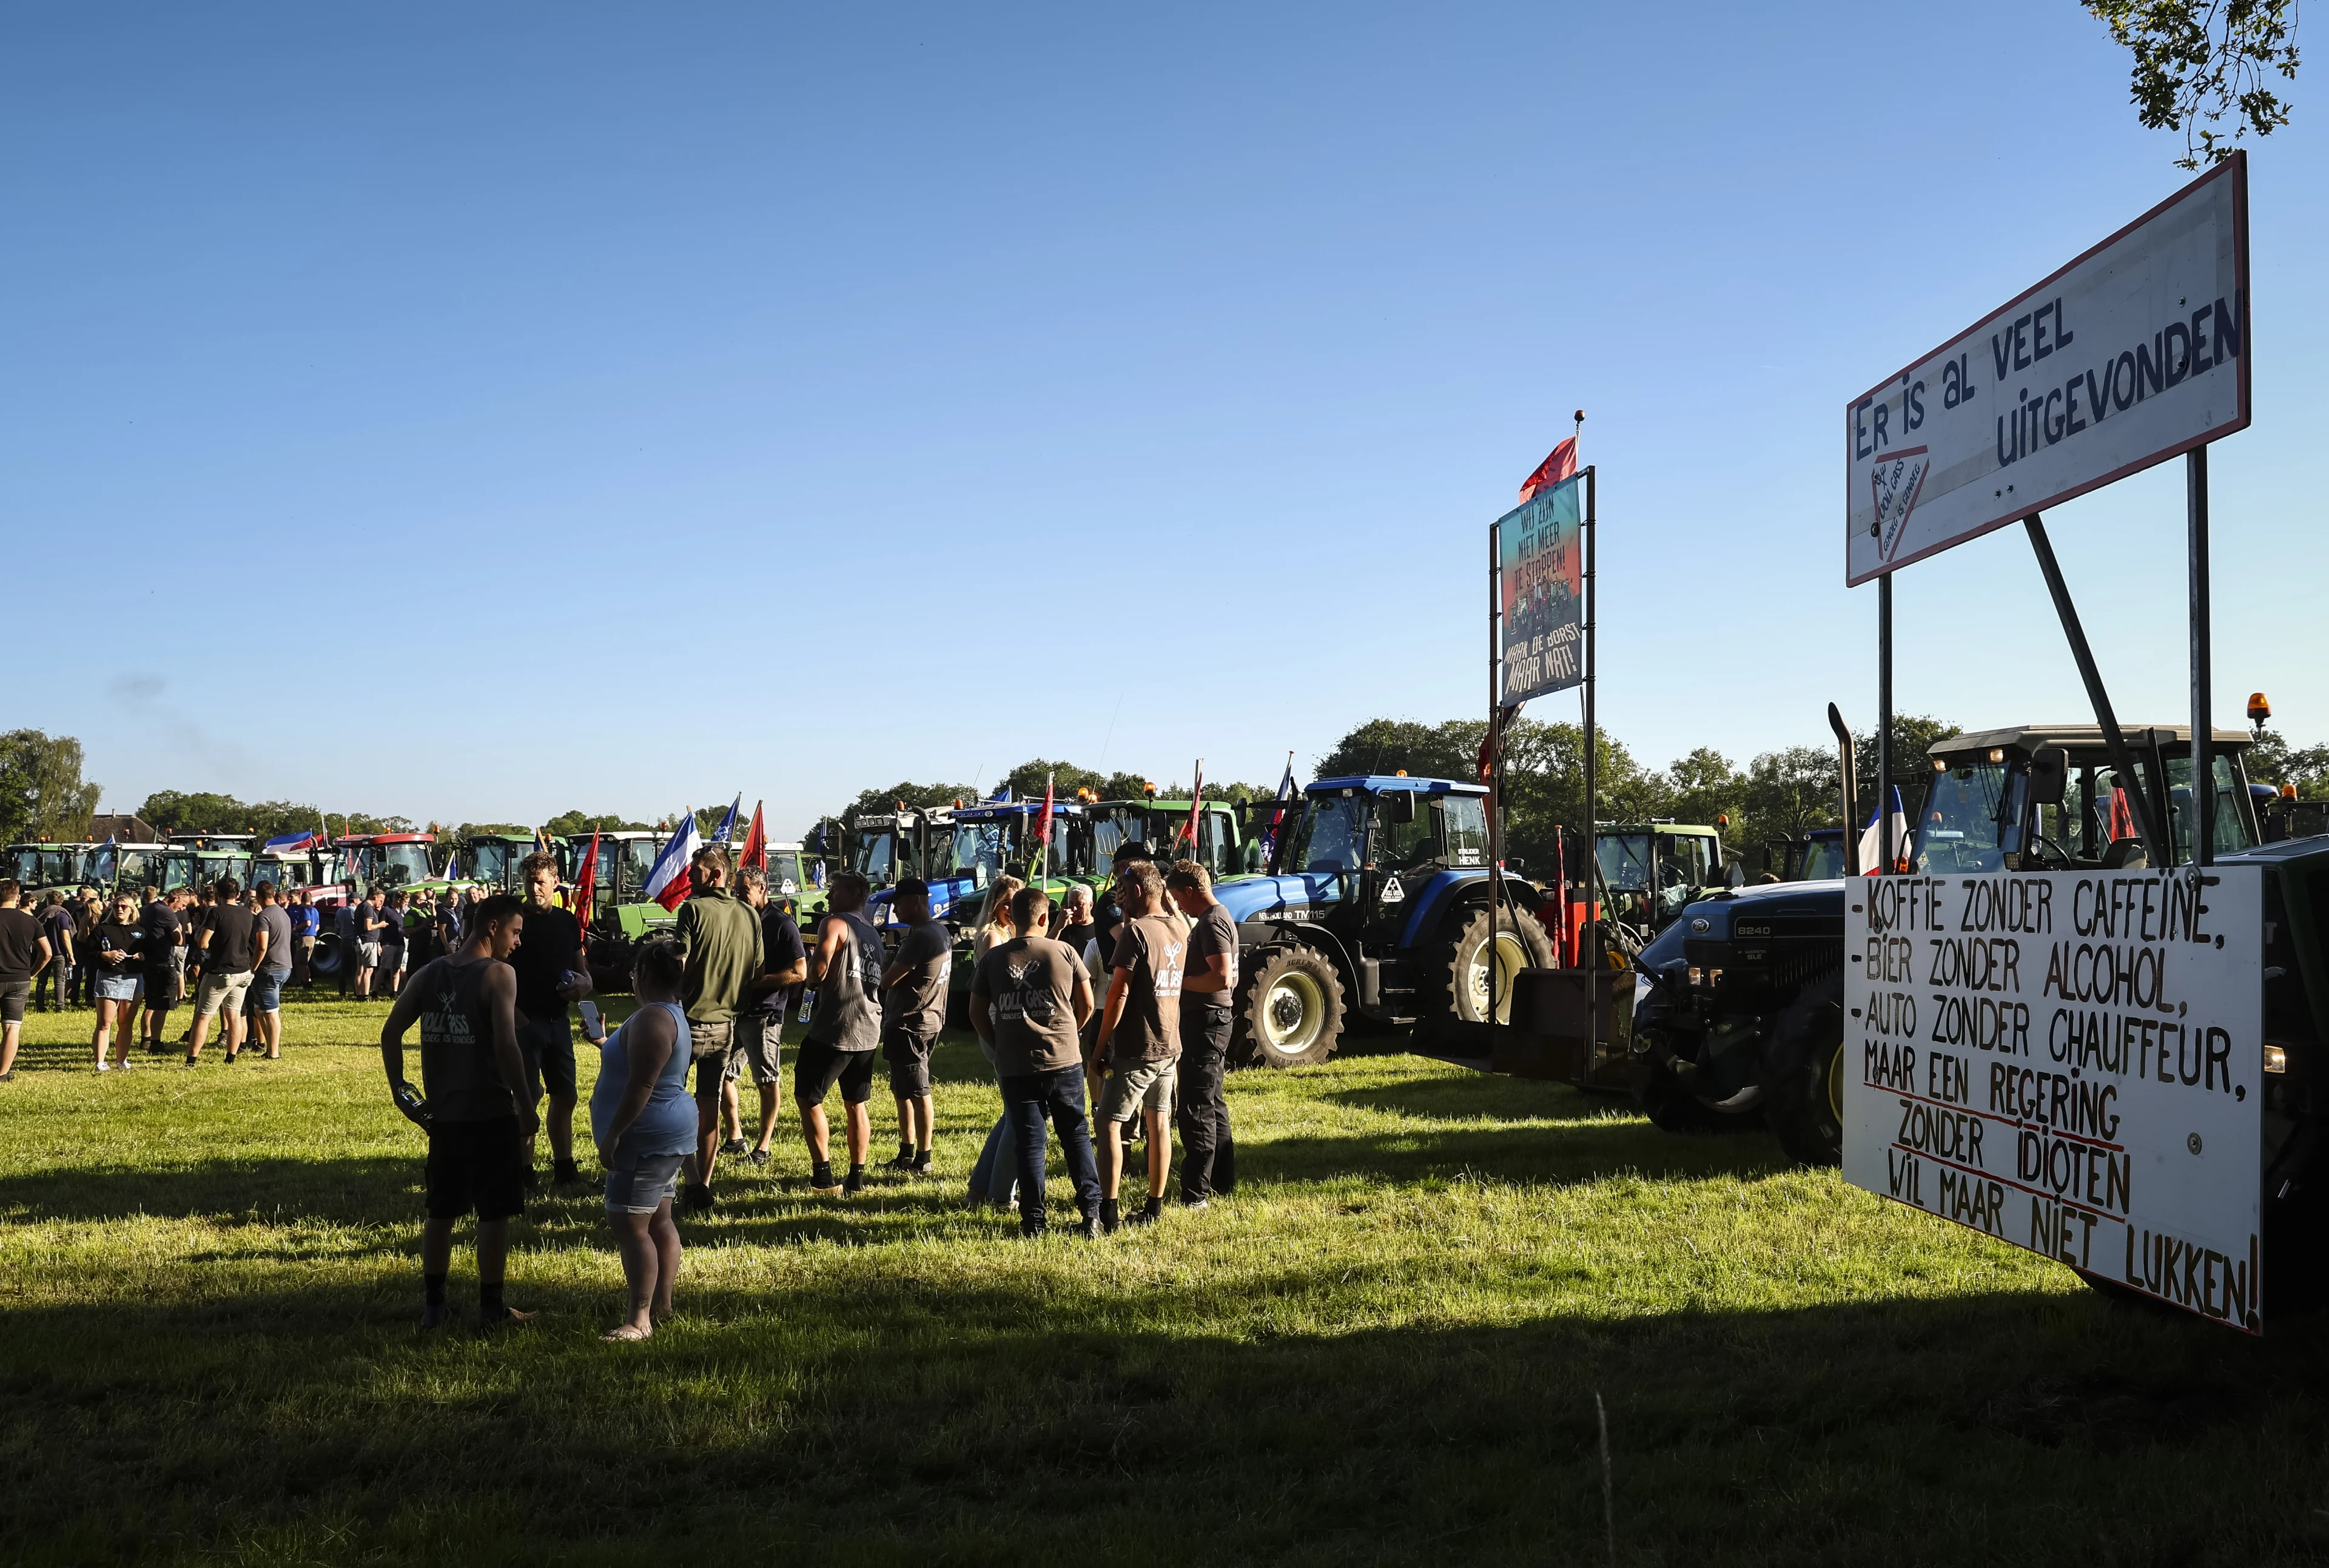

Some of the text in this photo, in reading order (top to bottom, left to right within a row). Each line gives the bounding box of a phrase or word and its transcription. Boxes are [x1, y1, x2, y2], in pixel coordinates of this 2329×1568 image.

[1856, 397, 1889, 462] ER
[1992, 297, 2073, 382] VEEL
[1890, 458, 1904, 491] GASS
[1520, 494, 1554, 534] WIJ ZIJN
[1883, 517, 1898, 552] GENOEG
[1902, 463, 1920, 505] GENOEG
[1518, 521, 1560, 564] NIET MEER
[1514, 545, 1565, 594] TE STOPPEN!
[1503, 622, 1581, 666] MAAK DE BORST
[1505, 656, 1541, 695] MAAR
[1545, 644, 1577, 679] NAT!
[1459, 856, 1480, 865] HENK
[1961, 878, 2052, 934] ZONDER
[1929, 937, 2020, 994] ZONDER
[2043, 940, 2188, 1018] ALCOHOL,
[443, 1034, 451, 1043] IS
[1932, 994, 2030, 1057] ZONDER
[2049, 1008, 2246, 1102] CHAUFFEUR,
[1864, 1038, 1915, 1093] MAAR
[1929, 1051, 1968, 1105] EEN
[1898, 1099, 1983, 1168] ZONDER
[1940, 1168, 2004, 1236] MAAR
[2126, 1223, 2260, 1333] LUKKEN!
